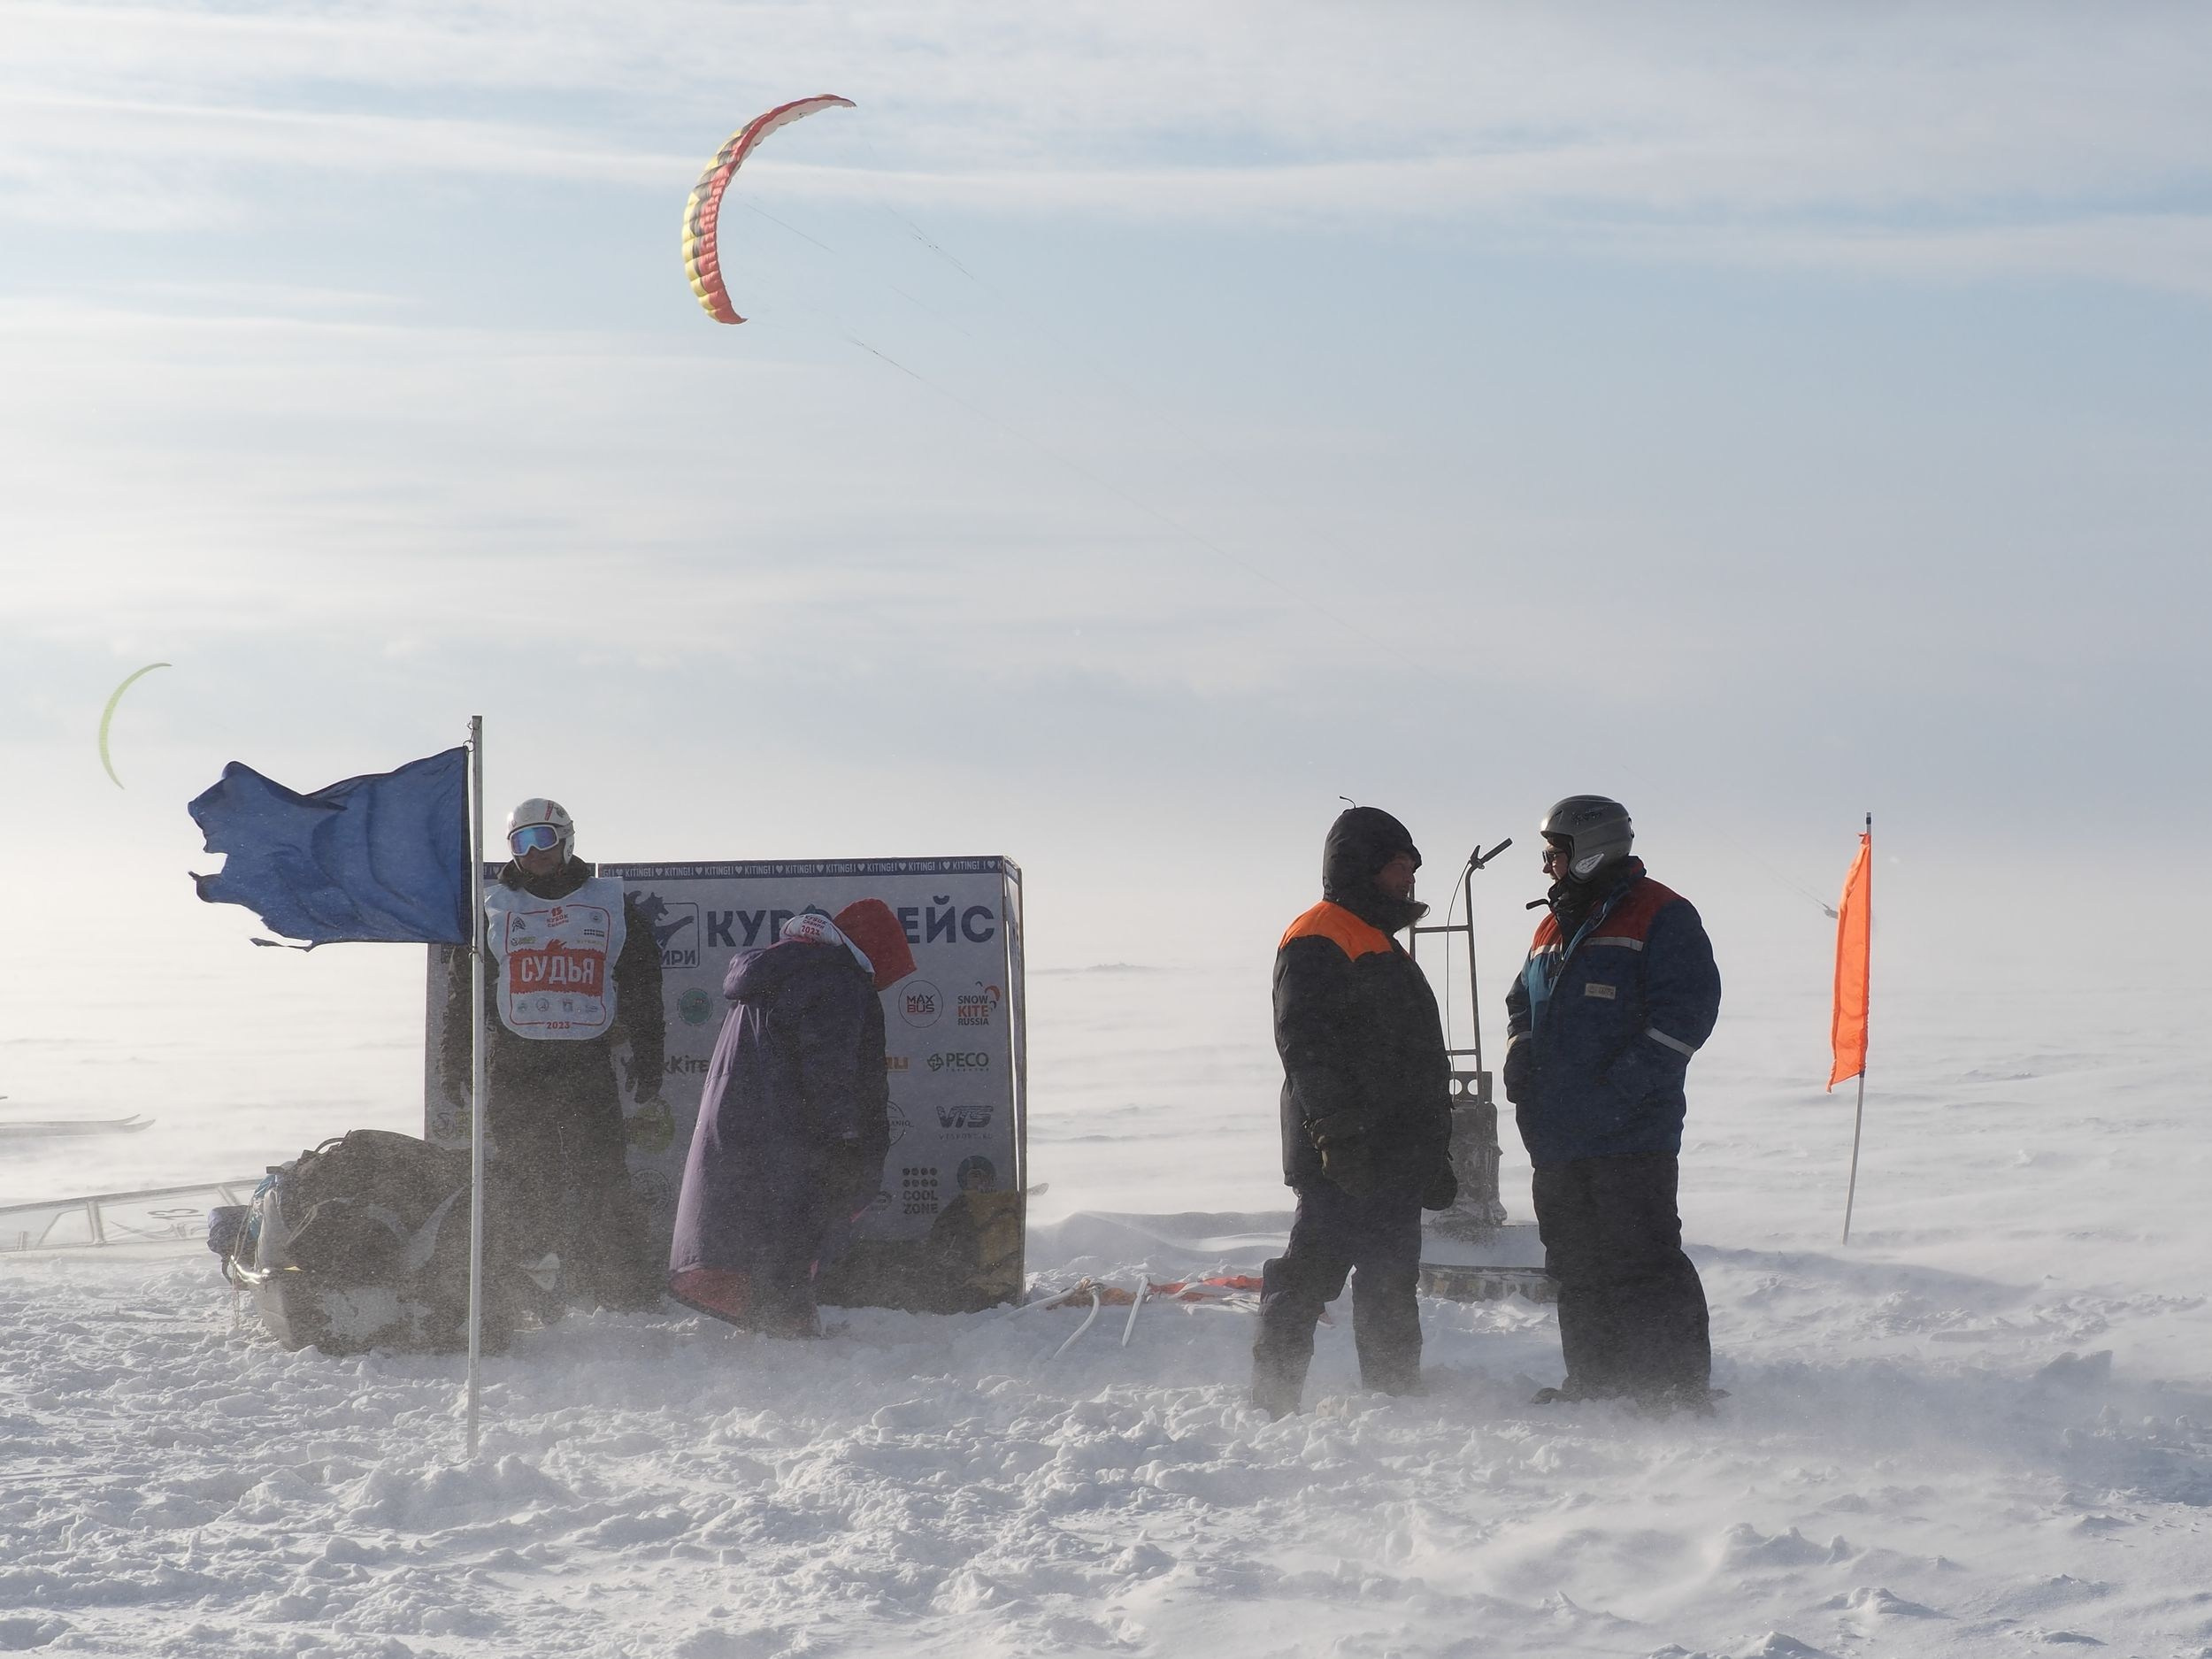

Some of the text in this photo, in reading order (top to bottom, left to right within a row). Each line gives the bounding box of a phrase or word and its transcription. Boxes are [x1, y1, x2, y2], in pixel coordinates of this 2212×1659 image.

[896, 895, 995, 945] ЕЙС
[520, 955, 595, 985] СУДЬЯ
[906, 994, 935, 1004] MAX
[957, 995, 989, 1004] SNOW
[906, 1004, 935, 1013] BUS
[957, 1005, 989, 1018] KITE
[547, 1021, 571, 1030] 2023
[936, 1105, 994, 1128] VTS
[902, 1190, 939, 1202] COOL
[902, 1203, 939, 1215] ZONE
